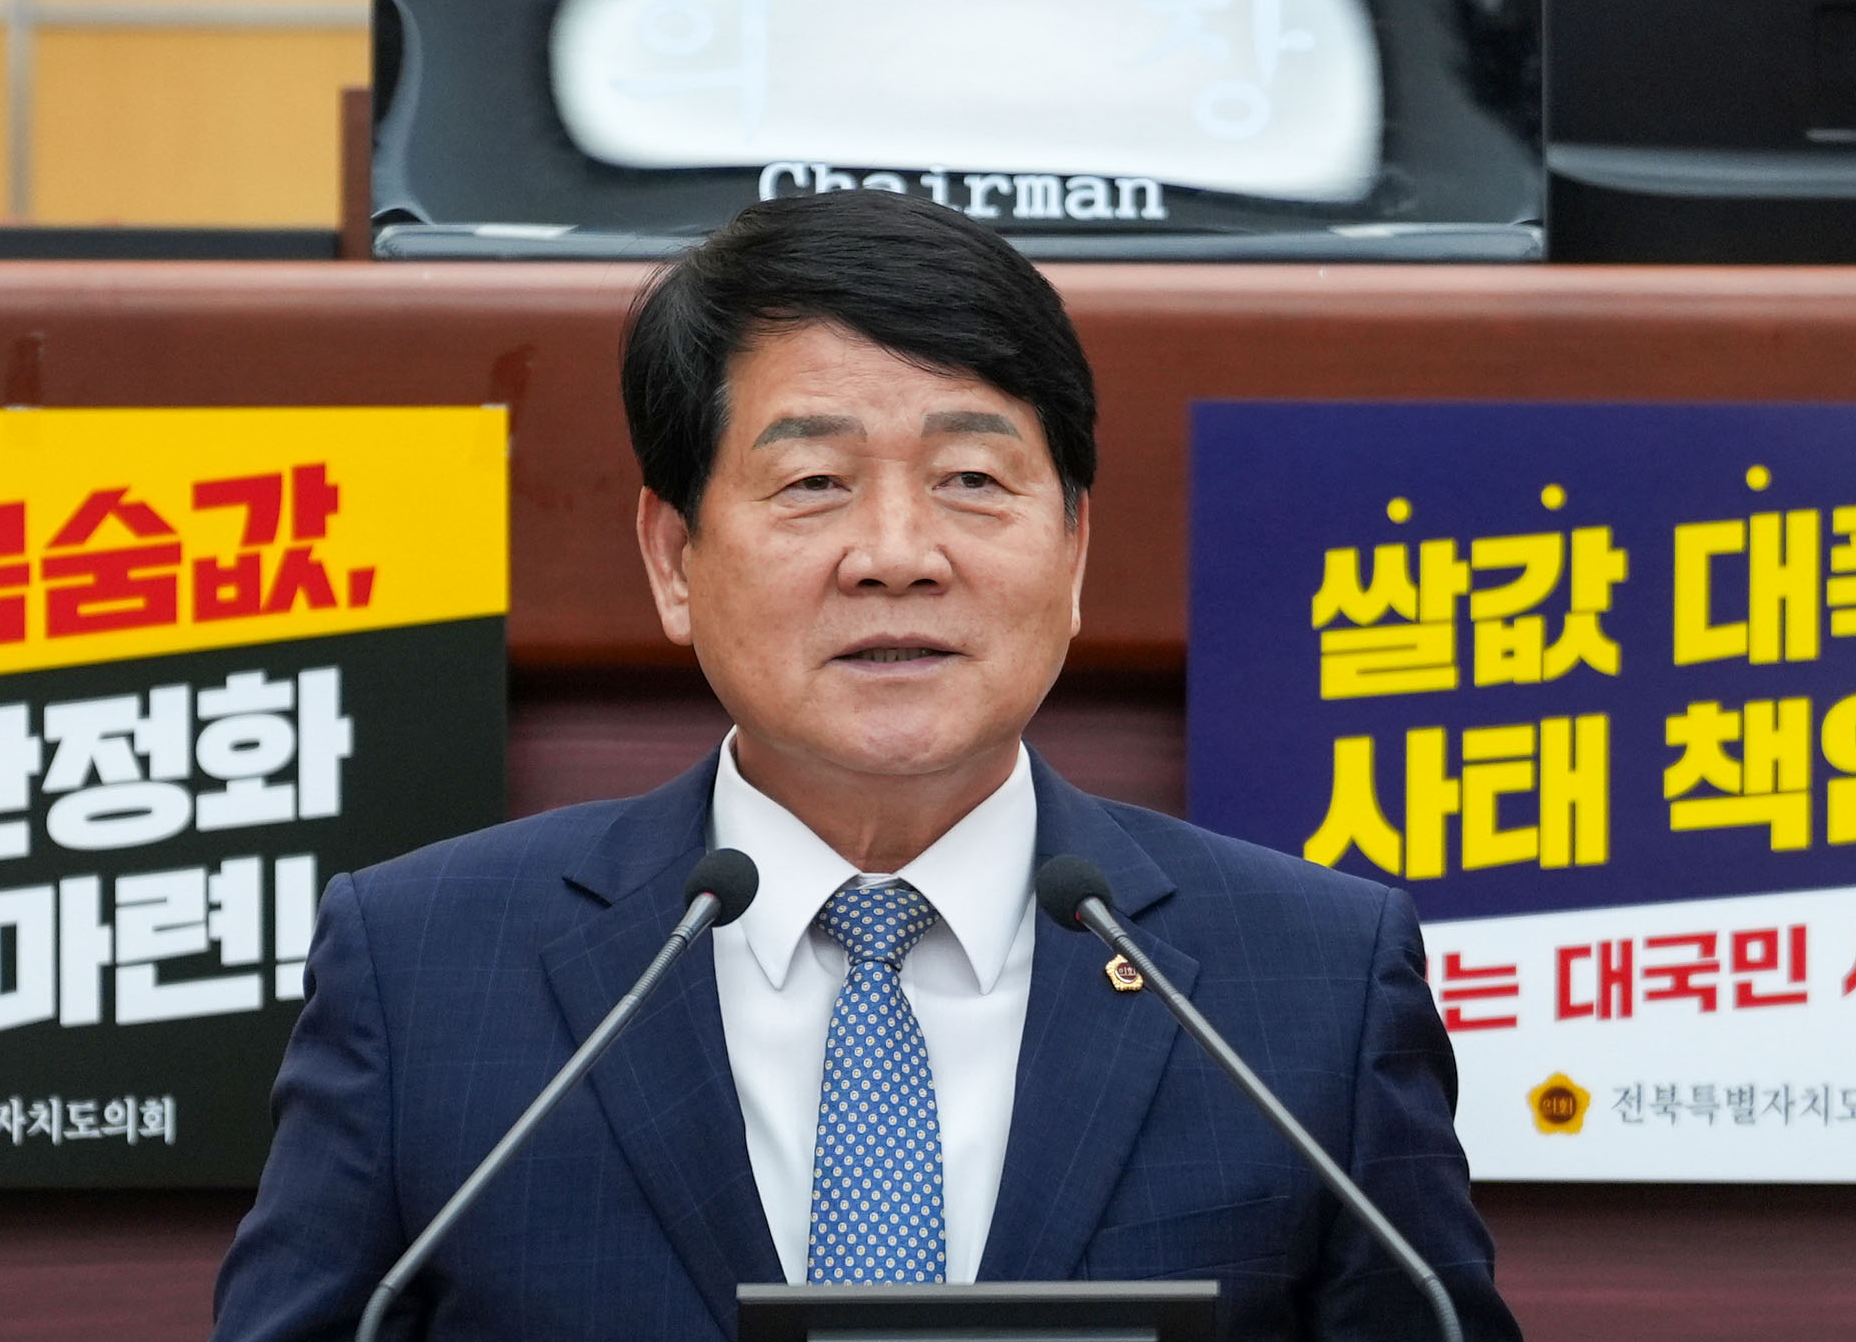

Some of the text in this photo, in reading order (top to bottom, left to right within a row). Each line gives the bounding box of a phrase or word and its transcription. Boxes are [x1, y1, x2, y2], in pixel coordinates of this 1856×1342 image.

[1312, 526, 1629, 700] 쌀값
[1303, 712, 1611, 881] 사태
[1424, 951, 1520, 1033] 는
[1553, 922, 1809, 1022] 대국민
